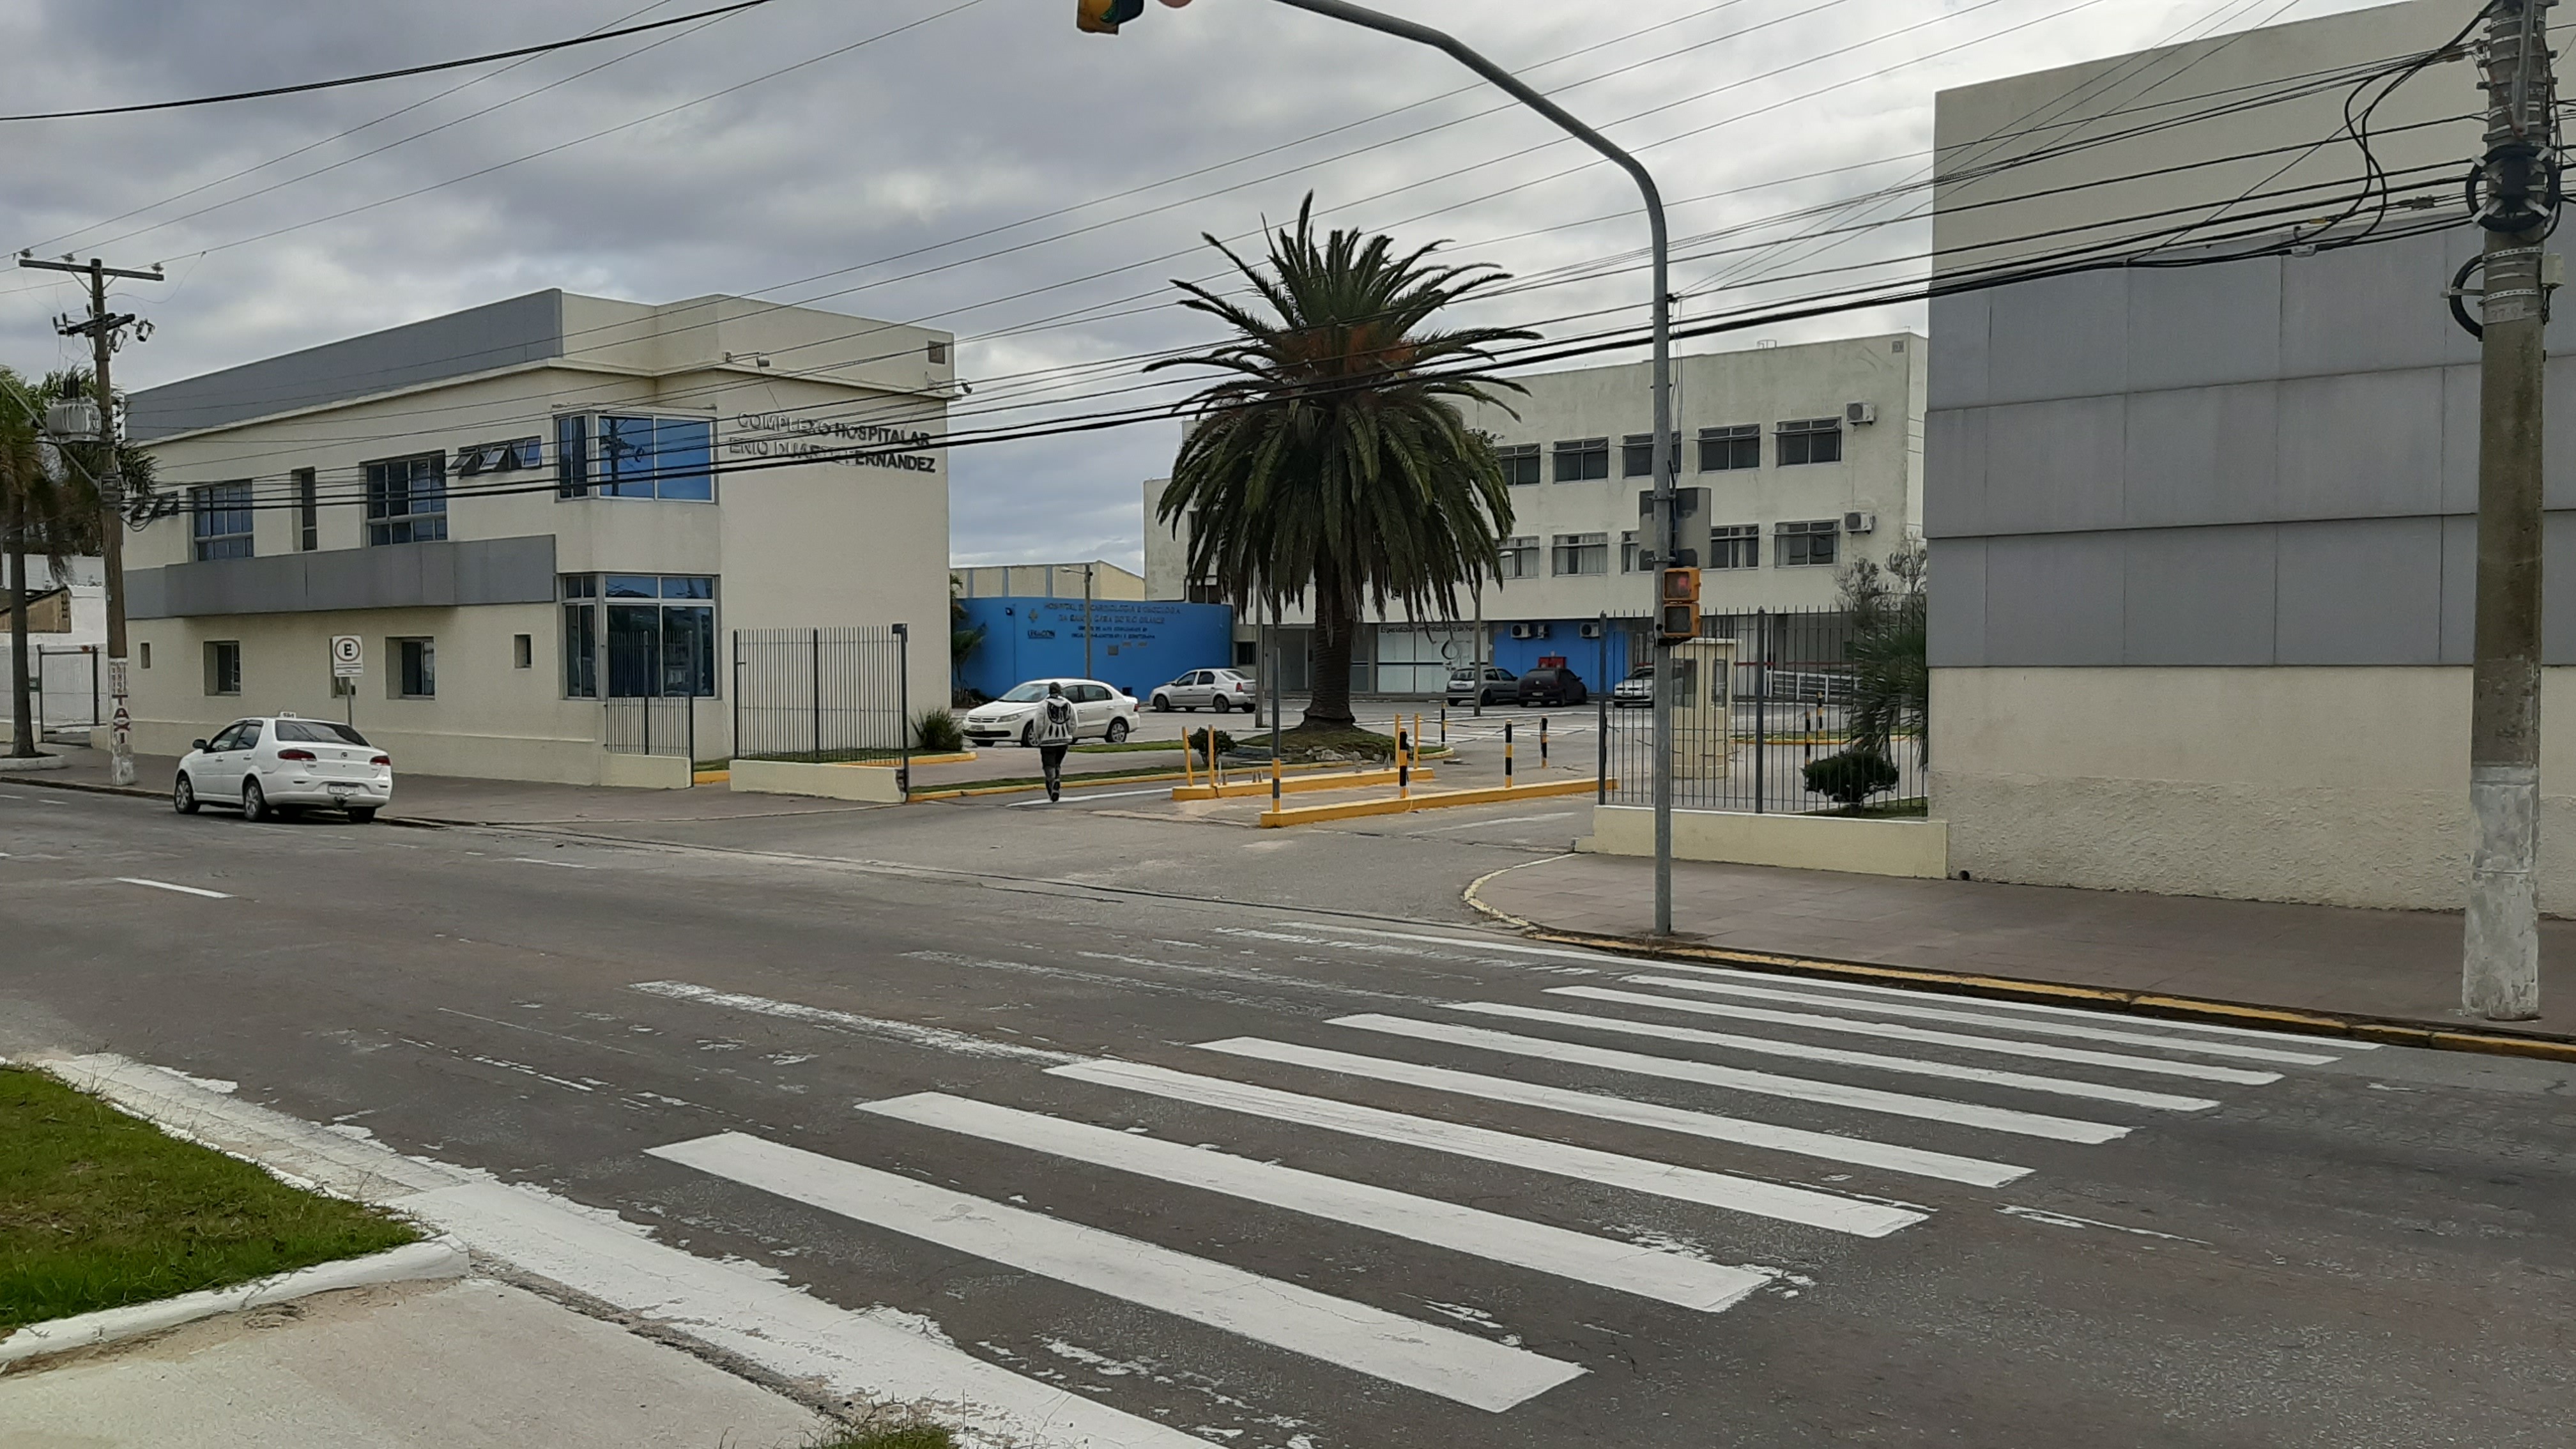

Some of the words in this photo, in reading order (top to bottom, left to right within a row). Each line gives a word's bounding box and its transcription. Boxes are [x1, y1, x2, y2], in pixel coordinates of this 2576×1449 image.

[835, 422, 931, 446] HOSPITALAR
[729, 437, 768, 456] ENIO
[344, 643, 353, 656] E
[112, 694, 130, 744] TAXI
